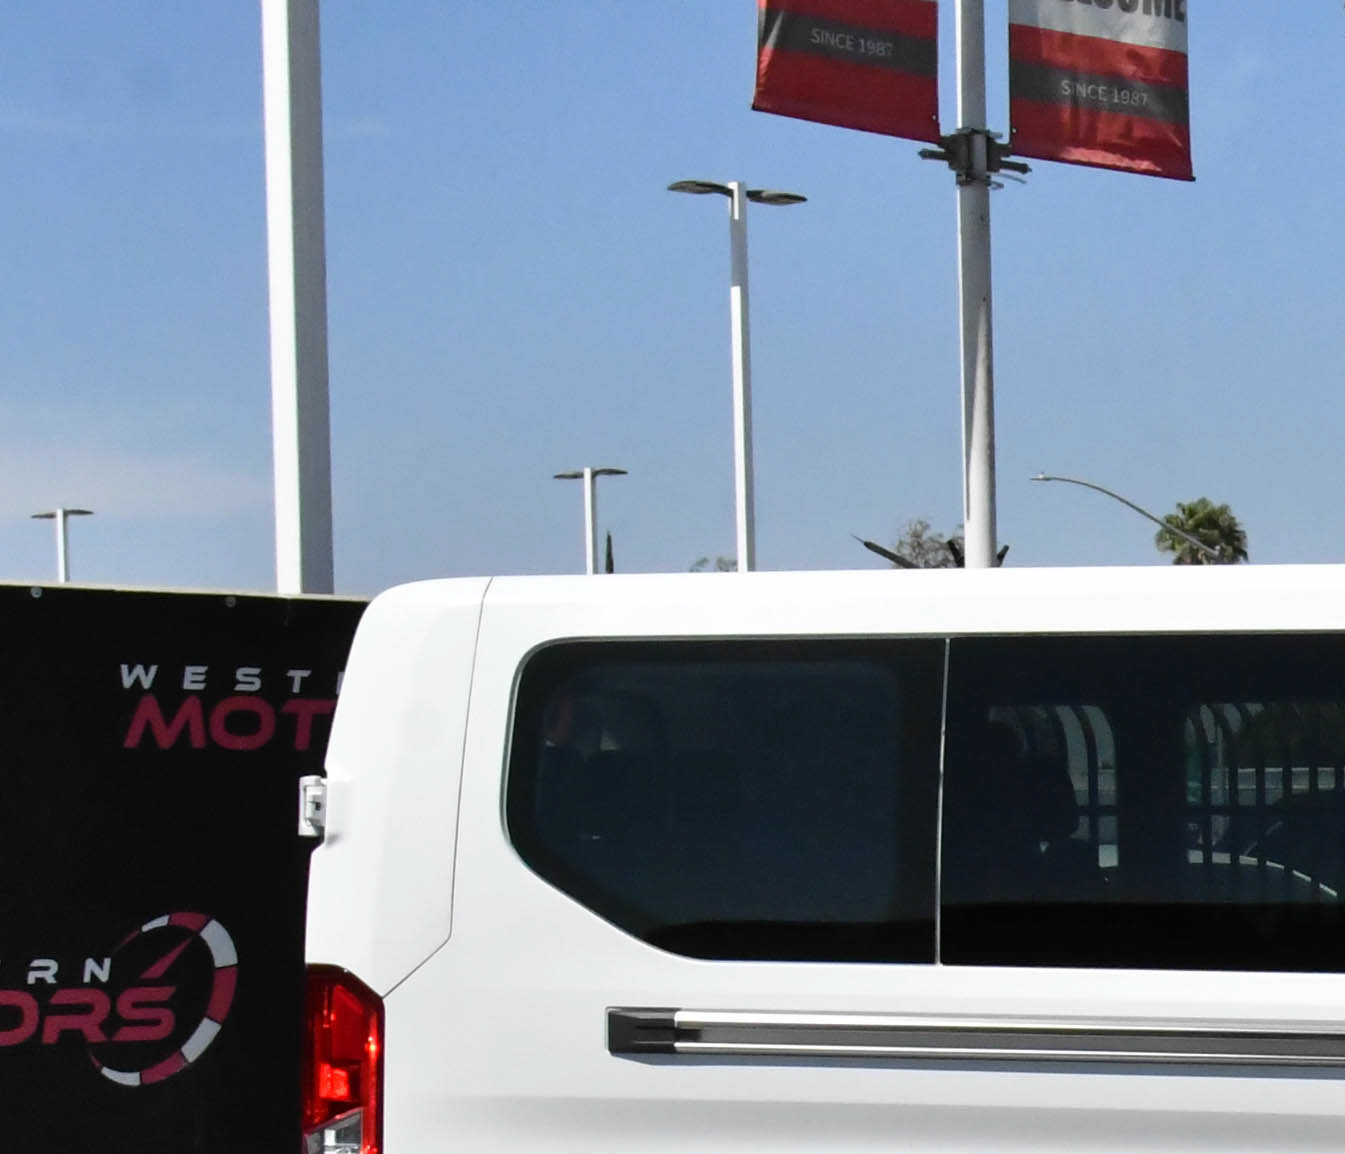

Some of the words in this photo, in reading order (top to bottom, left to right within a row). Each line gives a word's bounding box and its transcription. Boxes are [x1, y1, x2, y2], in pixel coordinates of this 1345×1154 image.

[810, 28, 855, 50] SINCE
[858, 38, 894, 57] 1987
[1061, 79, 1108, 101] SINCE
[1112, 89, 1149, 106] 1987
[119, 663, 346, 695] WEST
[0, 956, 112, 985] RN
